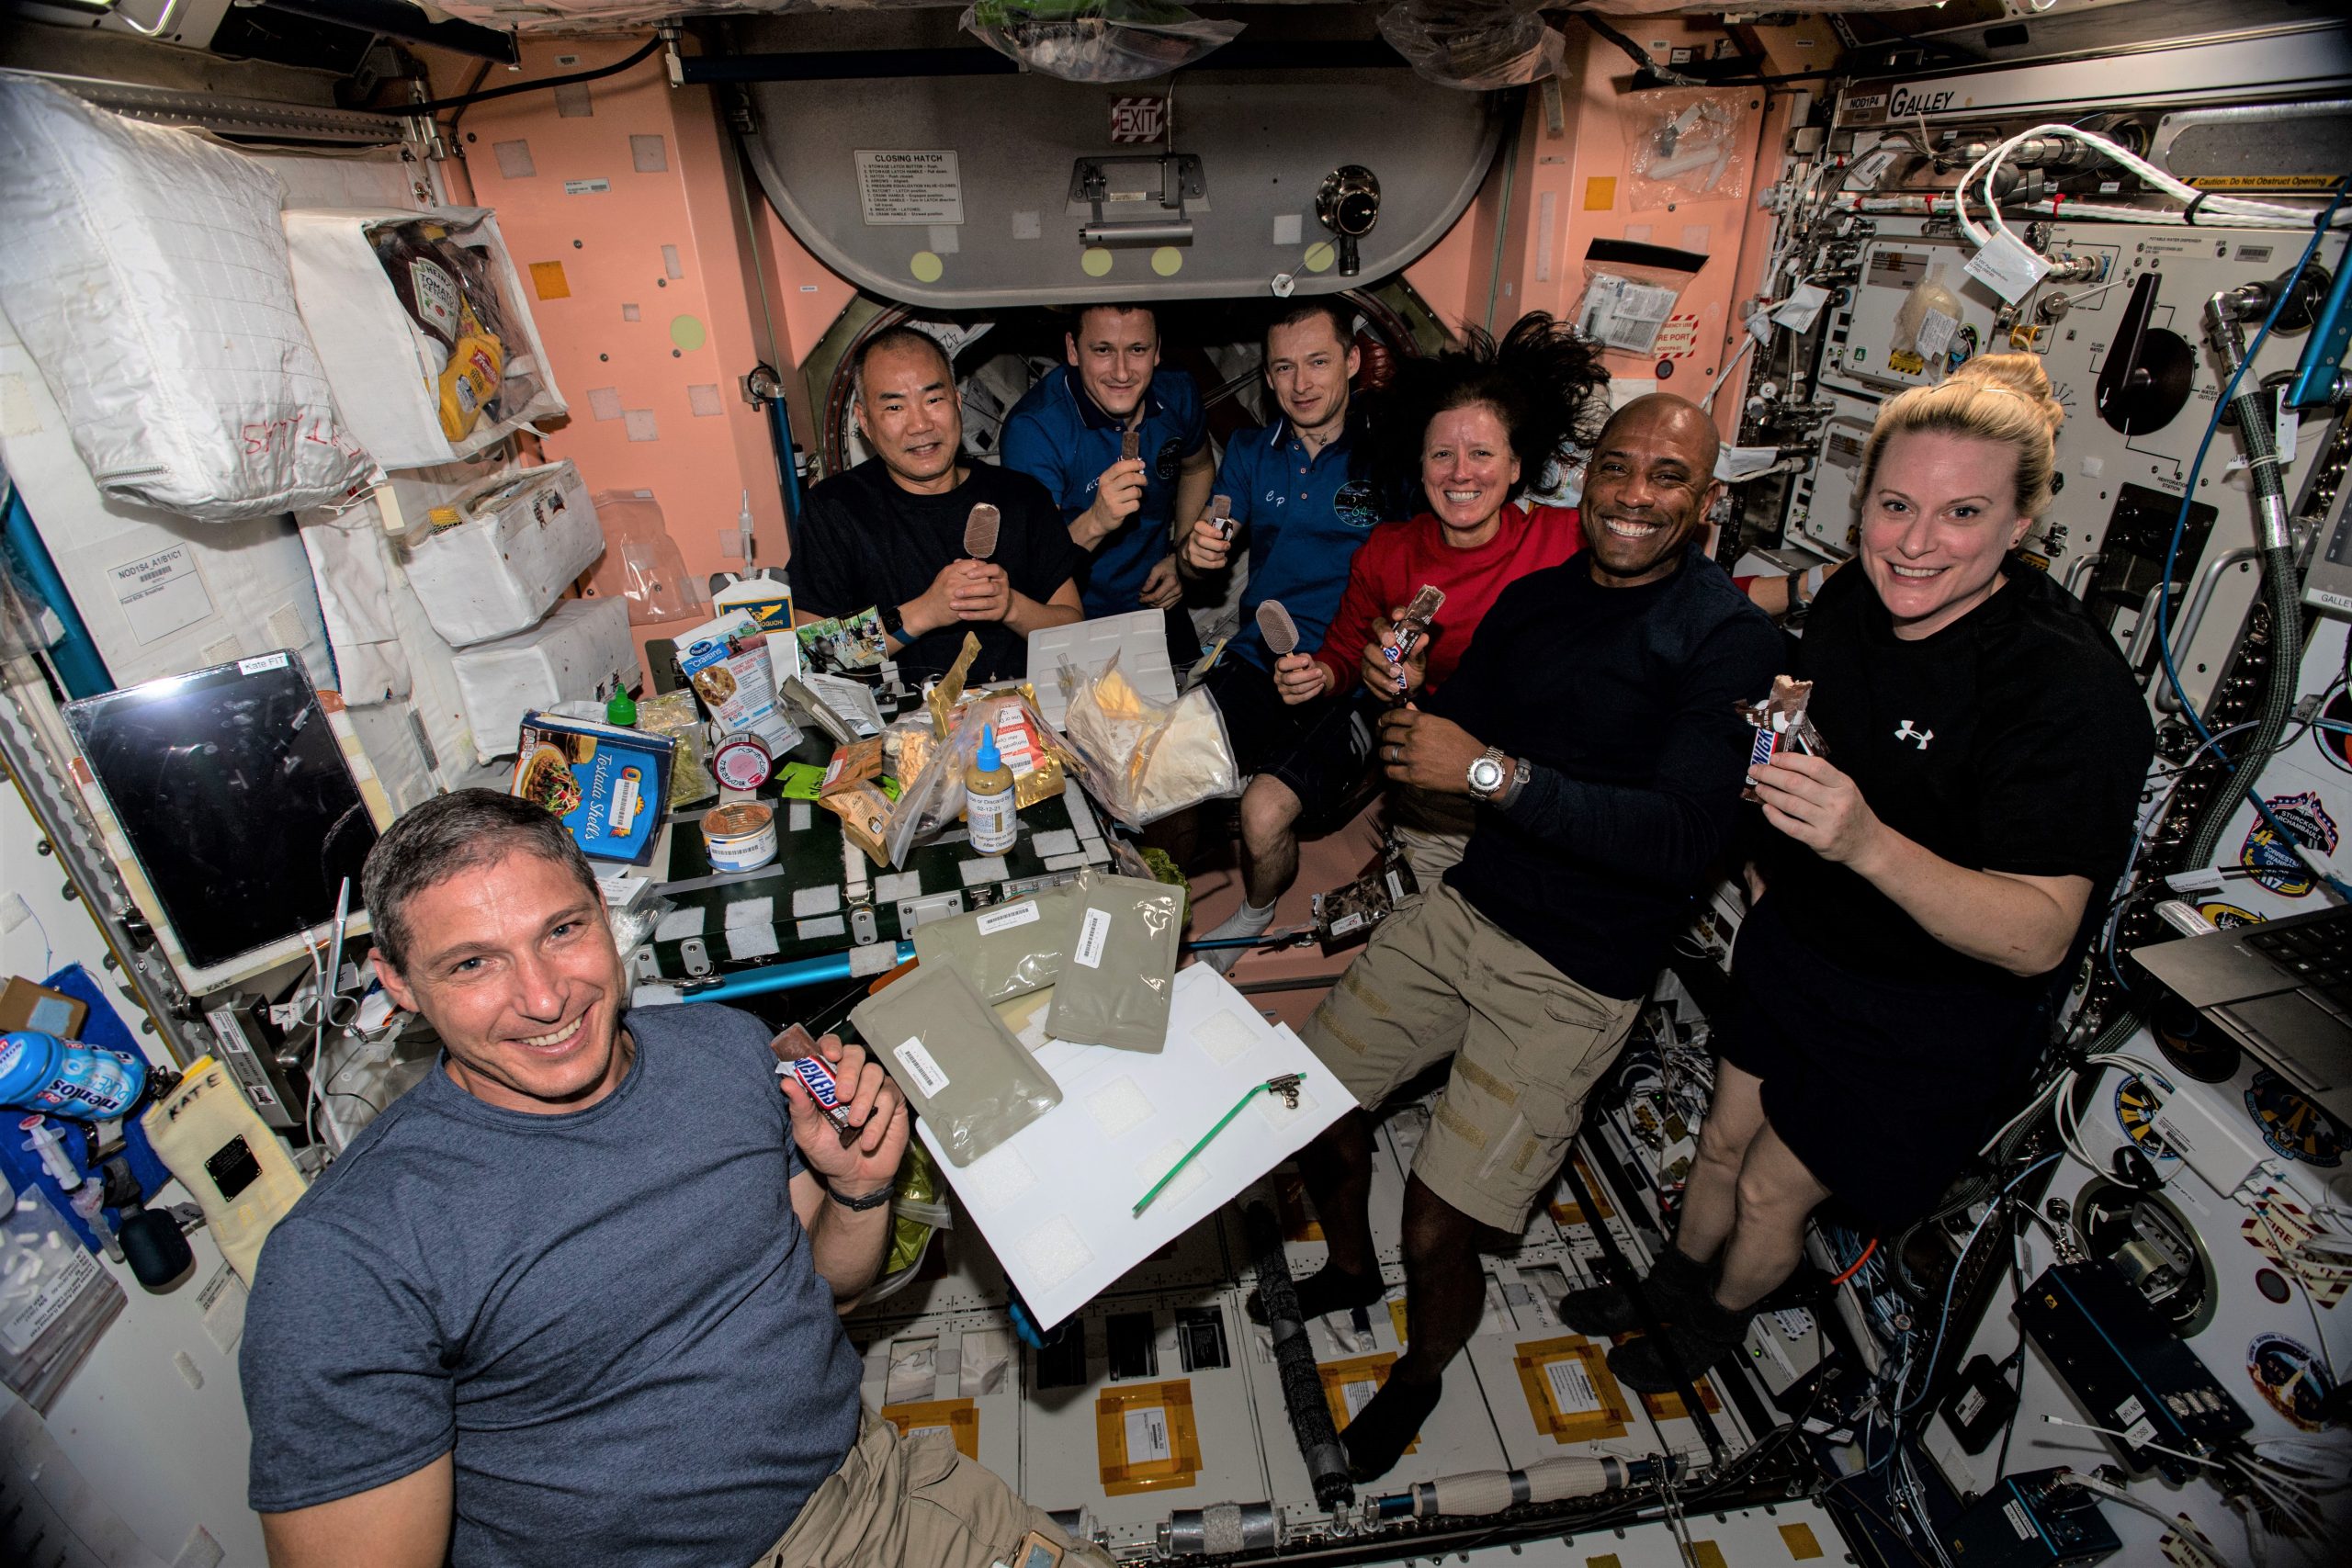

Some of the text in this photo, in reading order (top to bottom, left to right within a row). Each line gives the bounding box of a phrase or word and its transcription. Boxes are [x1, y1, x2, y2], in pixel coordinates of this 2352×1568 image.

[1849, 96, 1880, 108] NOD1P4
[1891, 87, 1954, 118] GALLEY
[1121, 109, 1156, 132] EXIT
[875, 154, 943, 163] CLOSING HATCH
[2291, 177, 2327, 186] Opening
[420, 273, 455, 302] TOMATO
[424, 264, 452, 288] HEINZ
[422, 282, 454, 309] KETCHUP
[1670, 333, 1690, 342] PORT
[2162, 482, 2181, 491] STATION
[1351, 505, 1368, 517] 64
[245, 656, 284, 671] Kate FIT
[592, 752, 613, 800] Tostada
[585, 800, 605, 840] Shells
[2274, 815, 2323, 840] ARCHAMBAULT
[2281, 810, 2321, 832] STURCKOW
[206, 979, 232, 993] KATE
[93, 1075, 130, 1101] PURE
[795, 1058, 838, 1105] ICKERS
[50, 1079, 119, 1111] mentos
[168, 1072, 221, 1122] KATE
[2267, 1135, 2290, 1158] STOTT
[2265, 1214, 2294, 1247] FIRE
[2271, 1204, 2313, 1239] EMERGEN
[2177, 1539, 2202, 1566] FIRE
